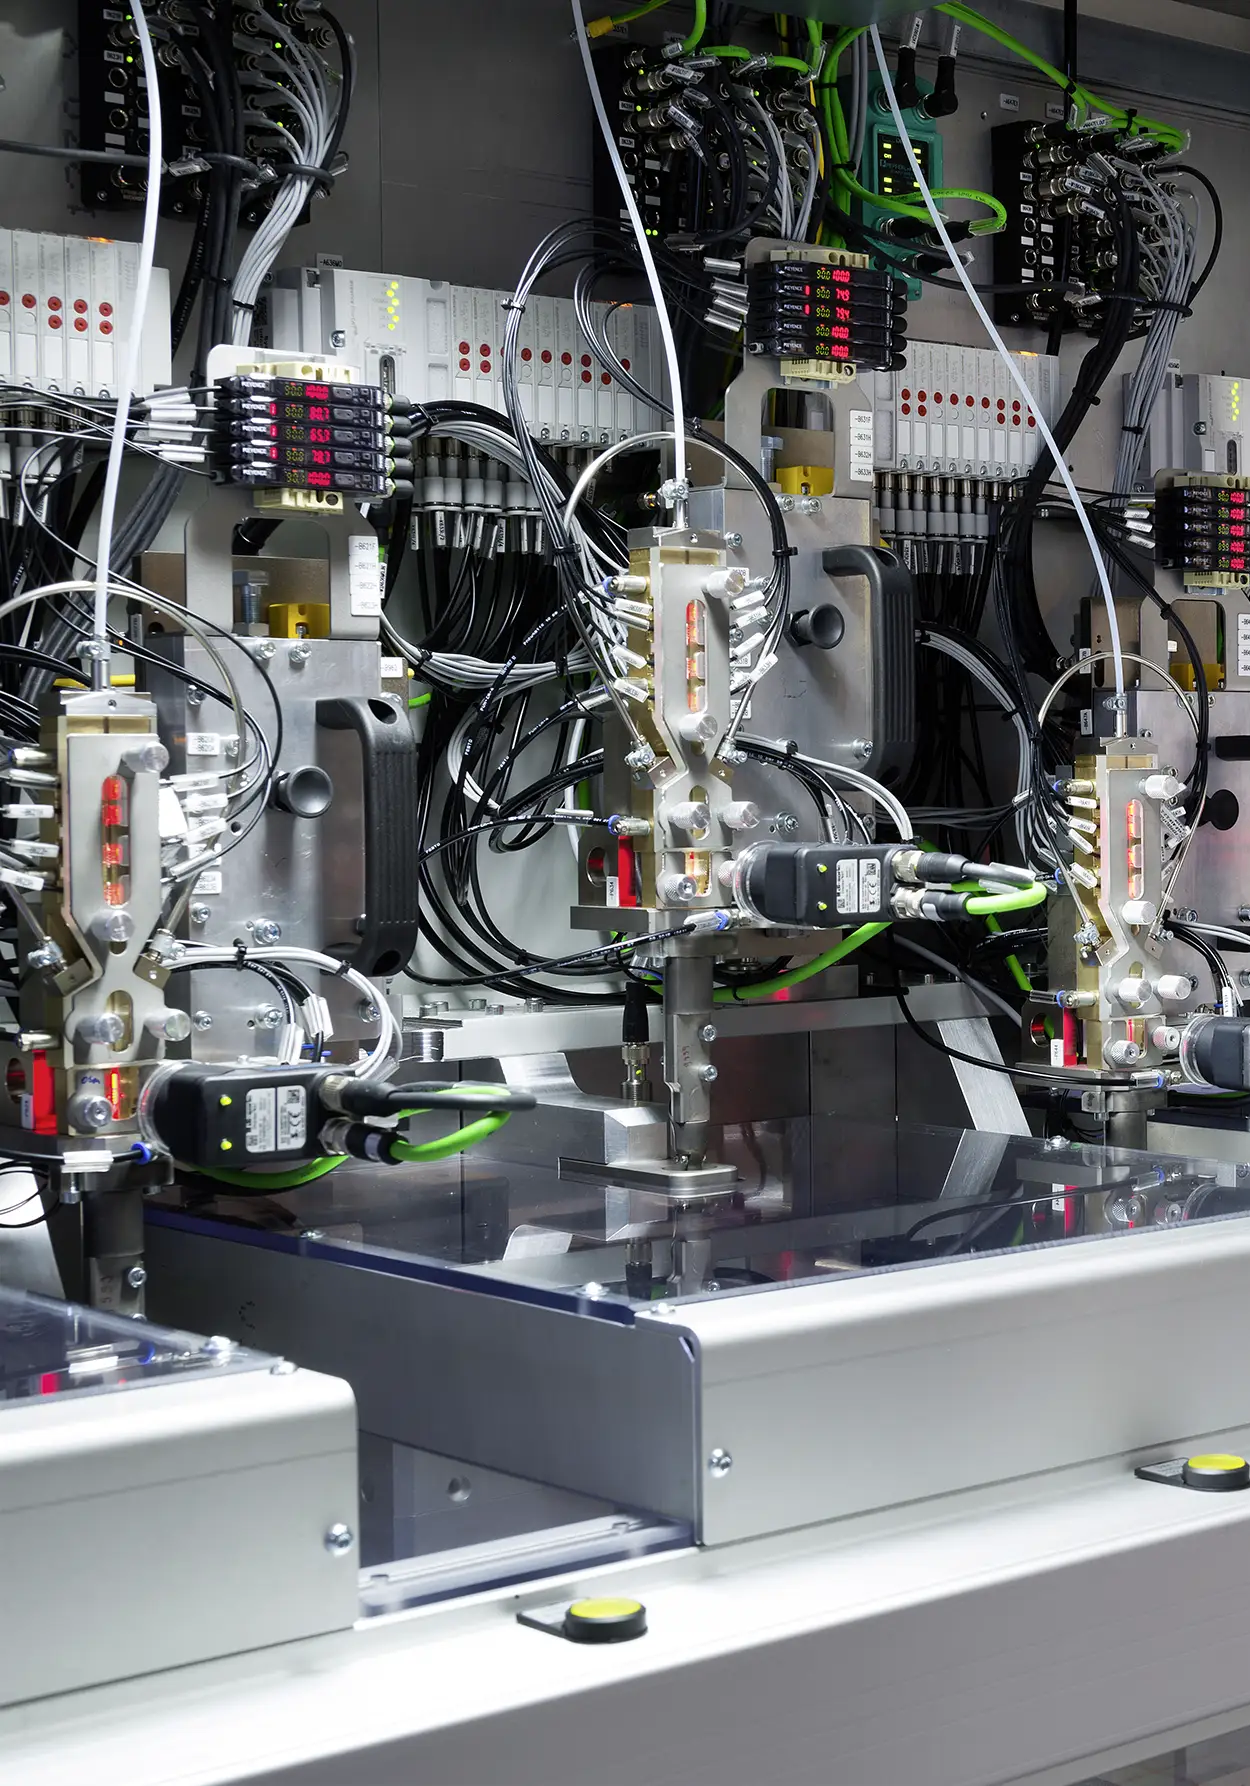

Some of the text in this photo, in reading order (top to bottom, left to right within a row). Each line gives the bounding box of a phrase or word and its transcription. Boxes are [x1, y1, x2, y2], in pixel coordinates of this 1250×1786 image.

[242, 381, 266, 389] KEYENCE
[242, 403, 266, 411] KEYENCE
[243, 425, 267, 433] KEYENCE
[243, 447, 267, 455] KEYENCE
[243, 469, 267, 477] KEYENCE
